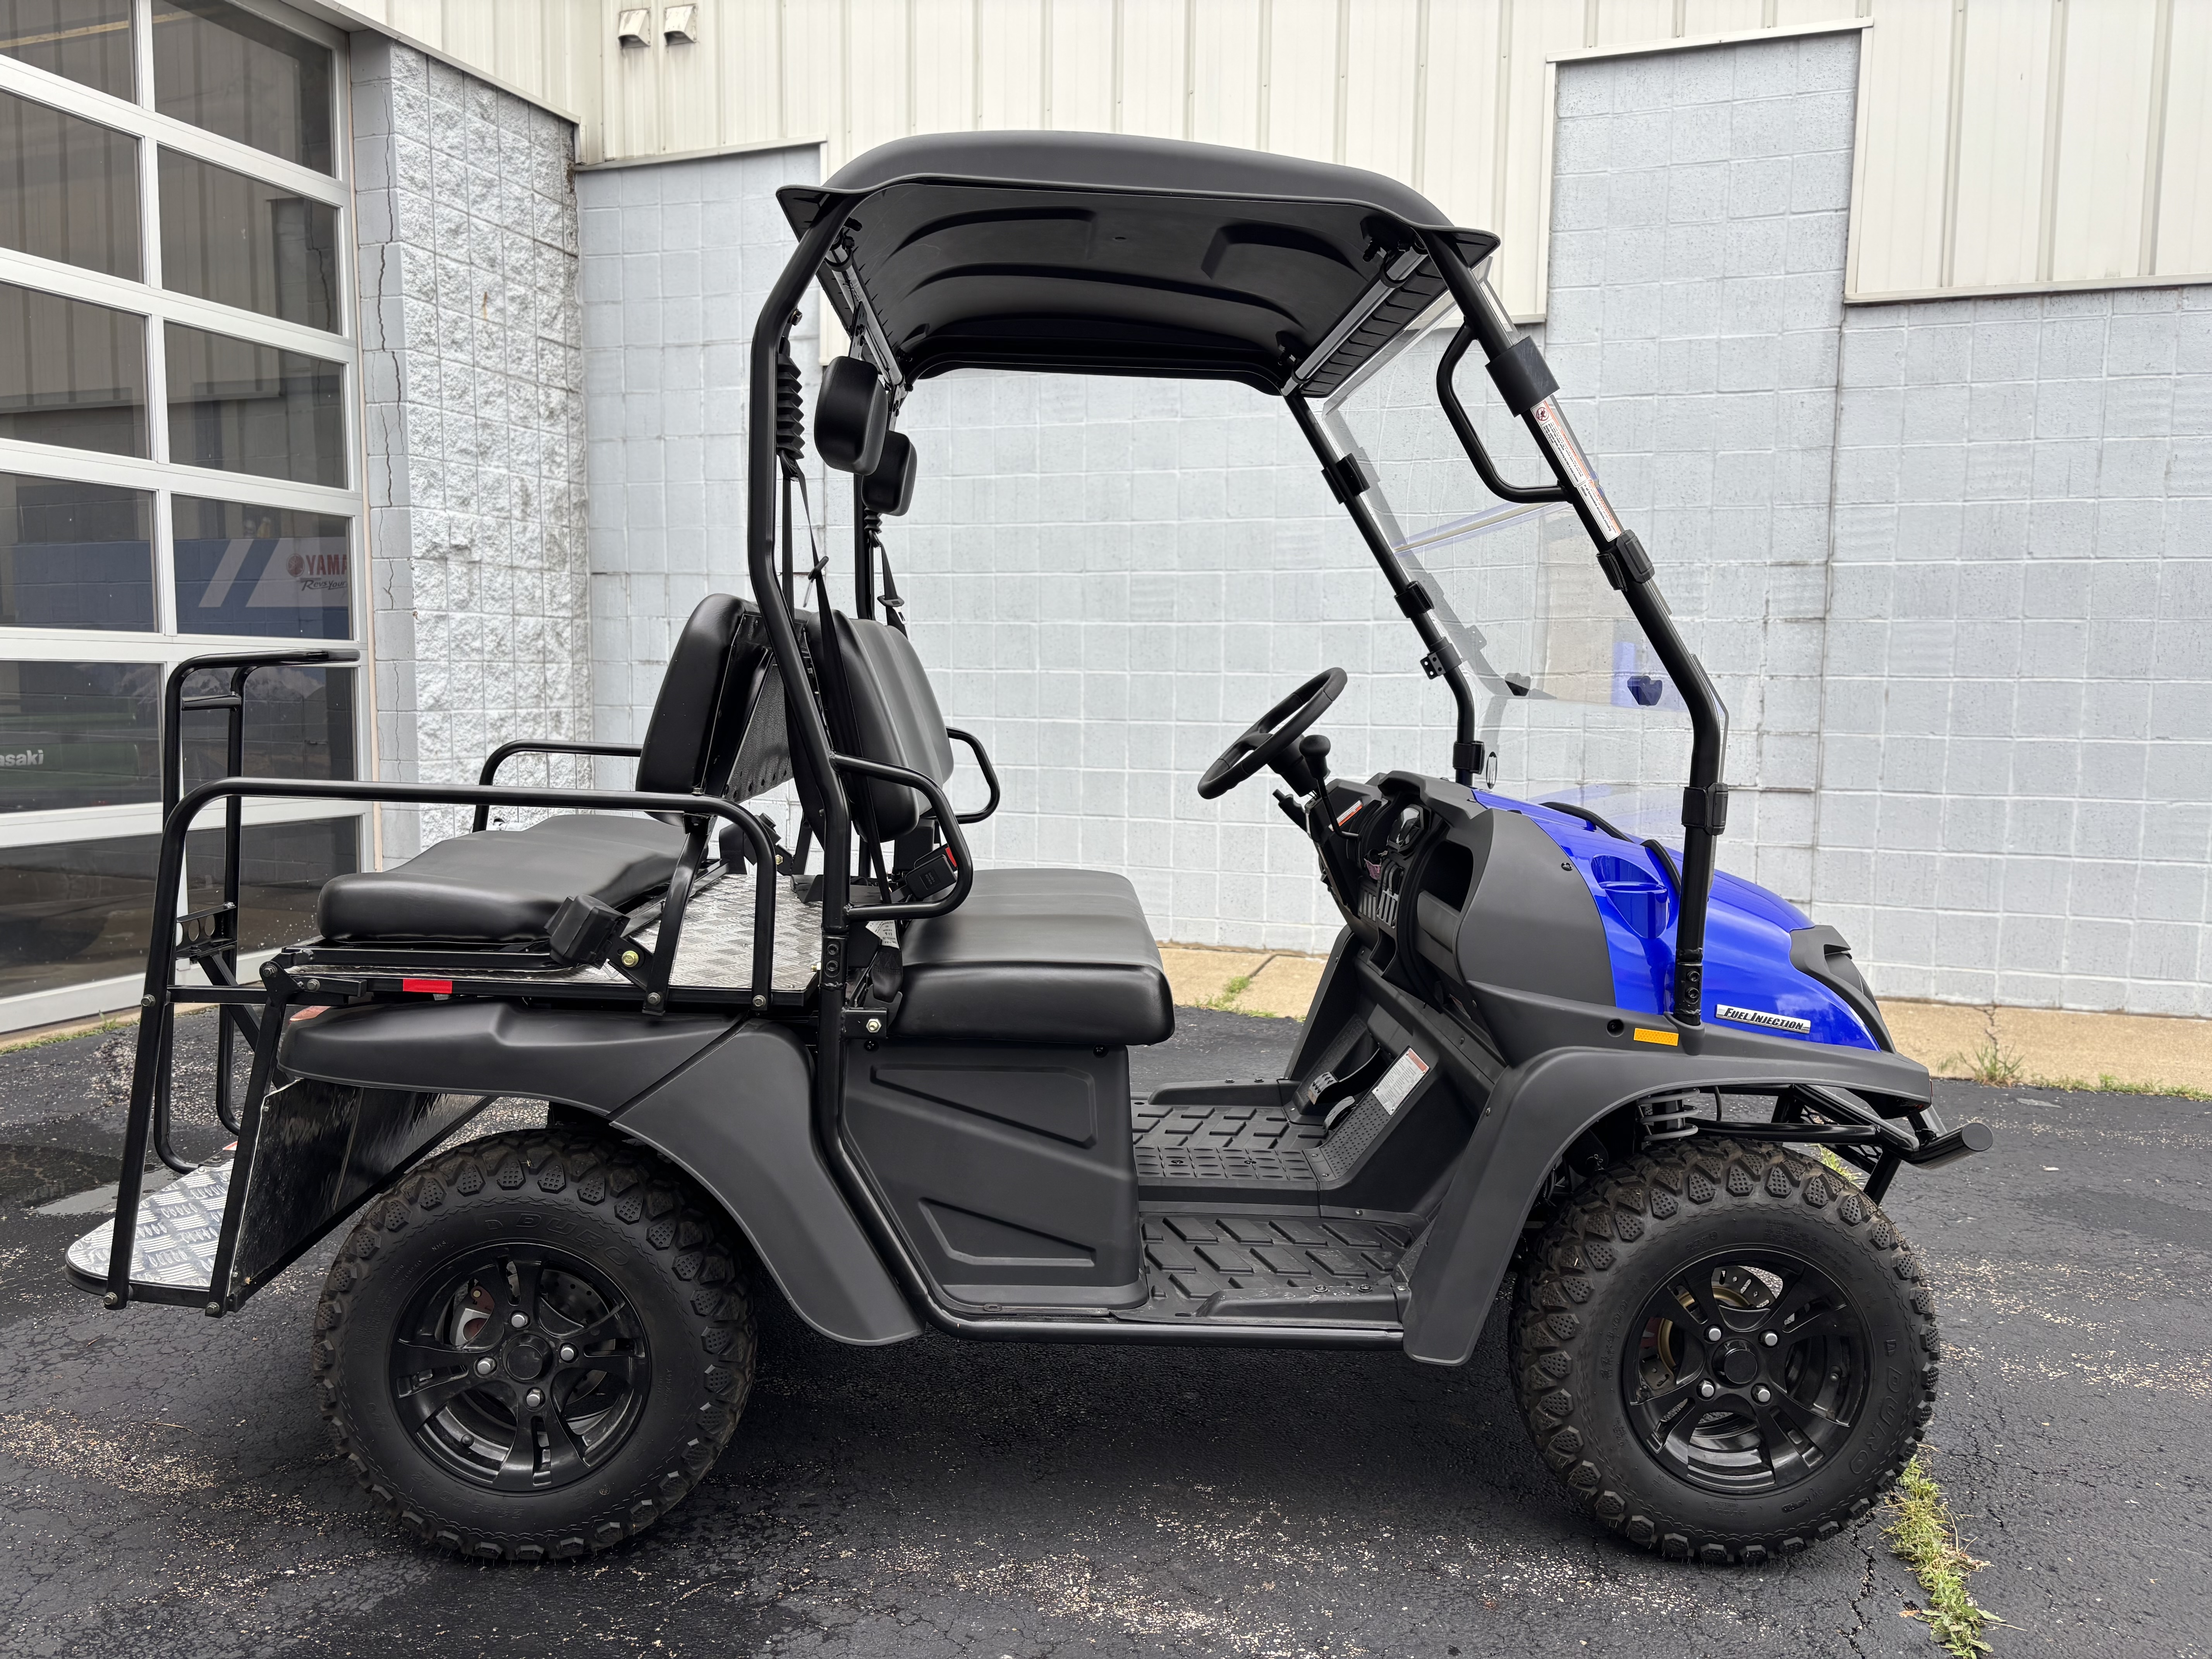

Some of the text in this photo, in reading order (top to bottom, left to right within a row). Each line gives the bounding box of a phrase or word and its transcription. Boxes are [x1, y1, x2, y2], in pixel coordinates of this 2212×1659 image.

[301, 579, 328, 591] Revs
[1724, 1008, 1804, 1030] FUEL INJECTION
[515, 1213, 629, 1266] DURO
